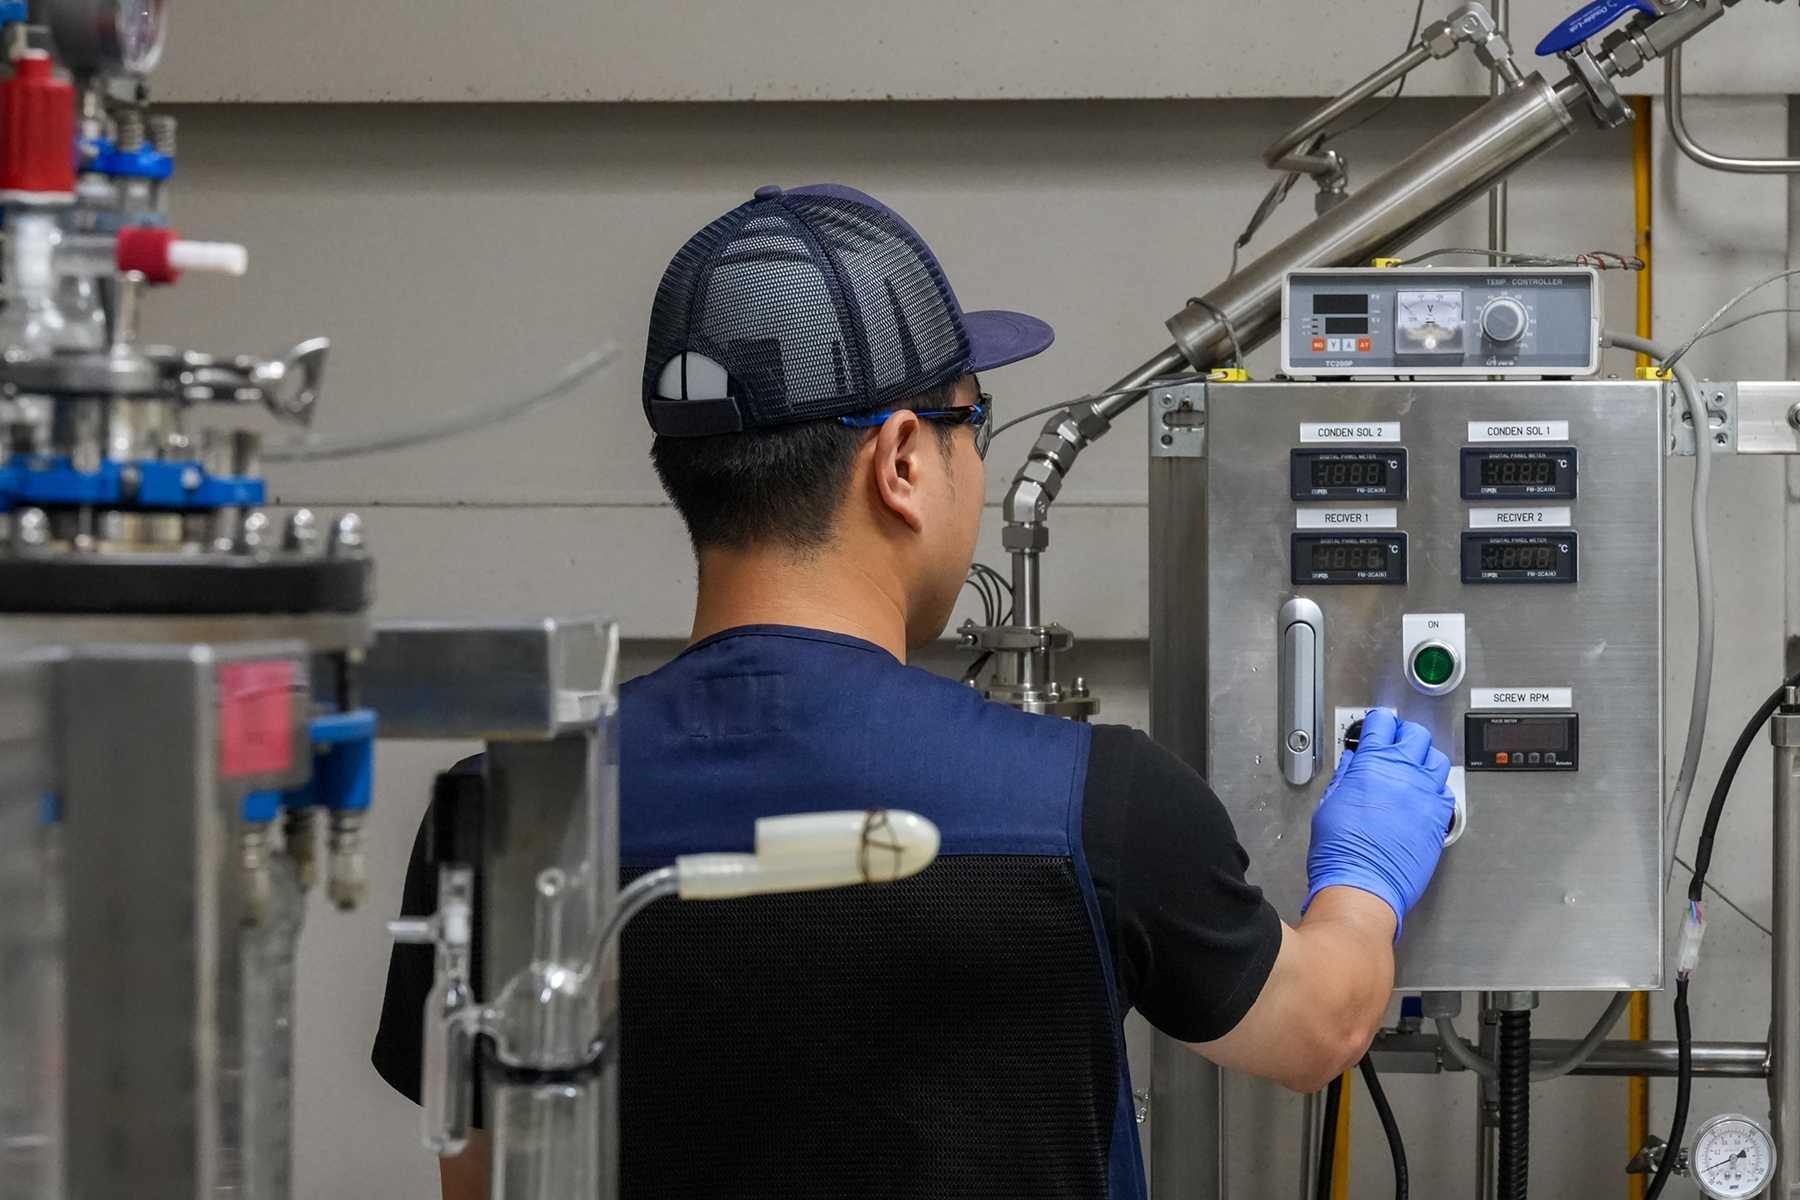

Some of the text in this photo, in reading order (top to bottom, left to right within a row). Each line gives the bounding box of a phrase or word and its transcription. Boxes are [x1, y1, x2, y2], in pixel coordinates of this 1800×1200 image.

[1427, 304, 1434, 312] V
[1318, 428, 1383, 437] CONDEN SOL 2
[1487, 426, 1550, 436] CONDEN SOL 1
[1388, 460, 1398, 469] °C
[1558, 459, 1568, 468] °C
[1325, 514, 1369, 522] RECIVER 1
[1497, 513, 1543, 522] RECIVER 2
[1389, 545, 1398, 553] °C
[1558, 544, 1568, 552] °C
[1493, 693, 1549, 702] SCREW RPM
